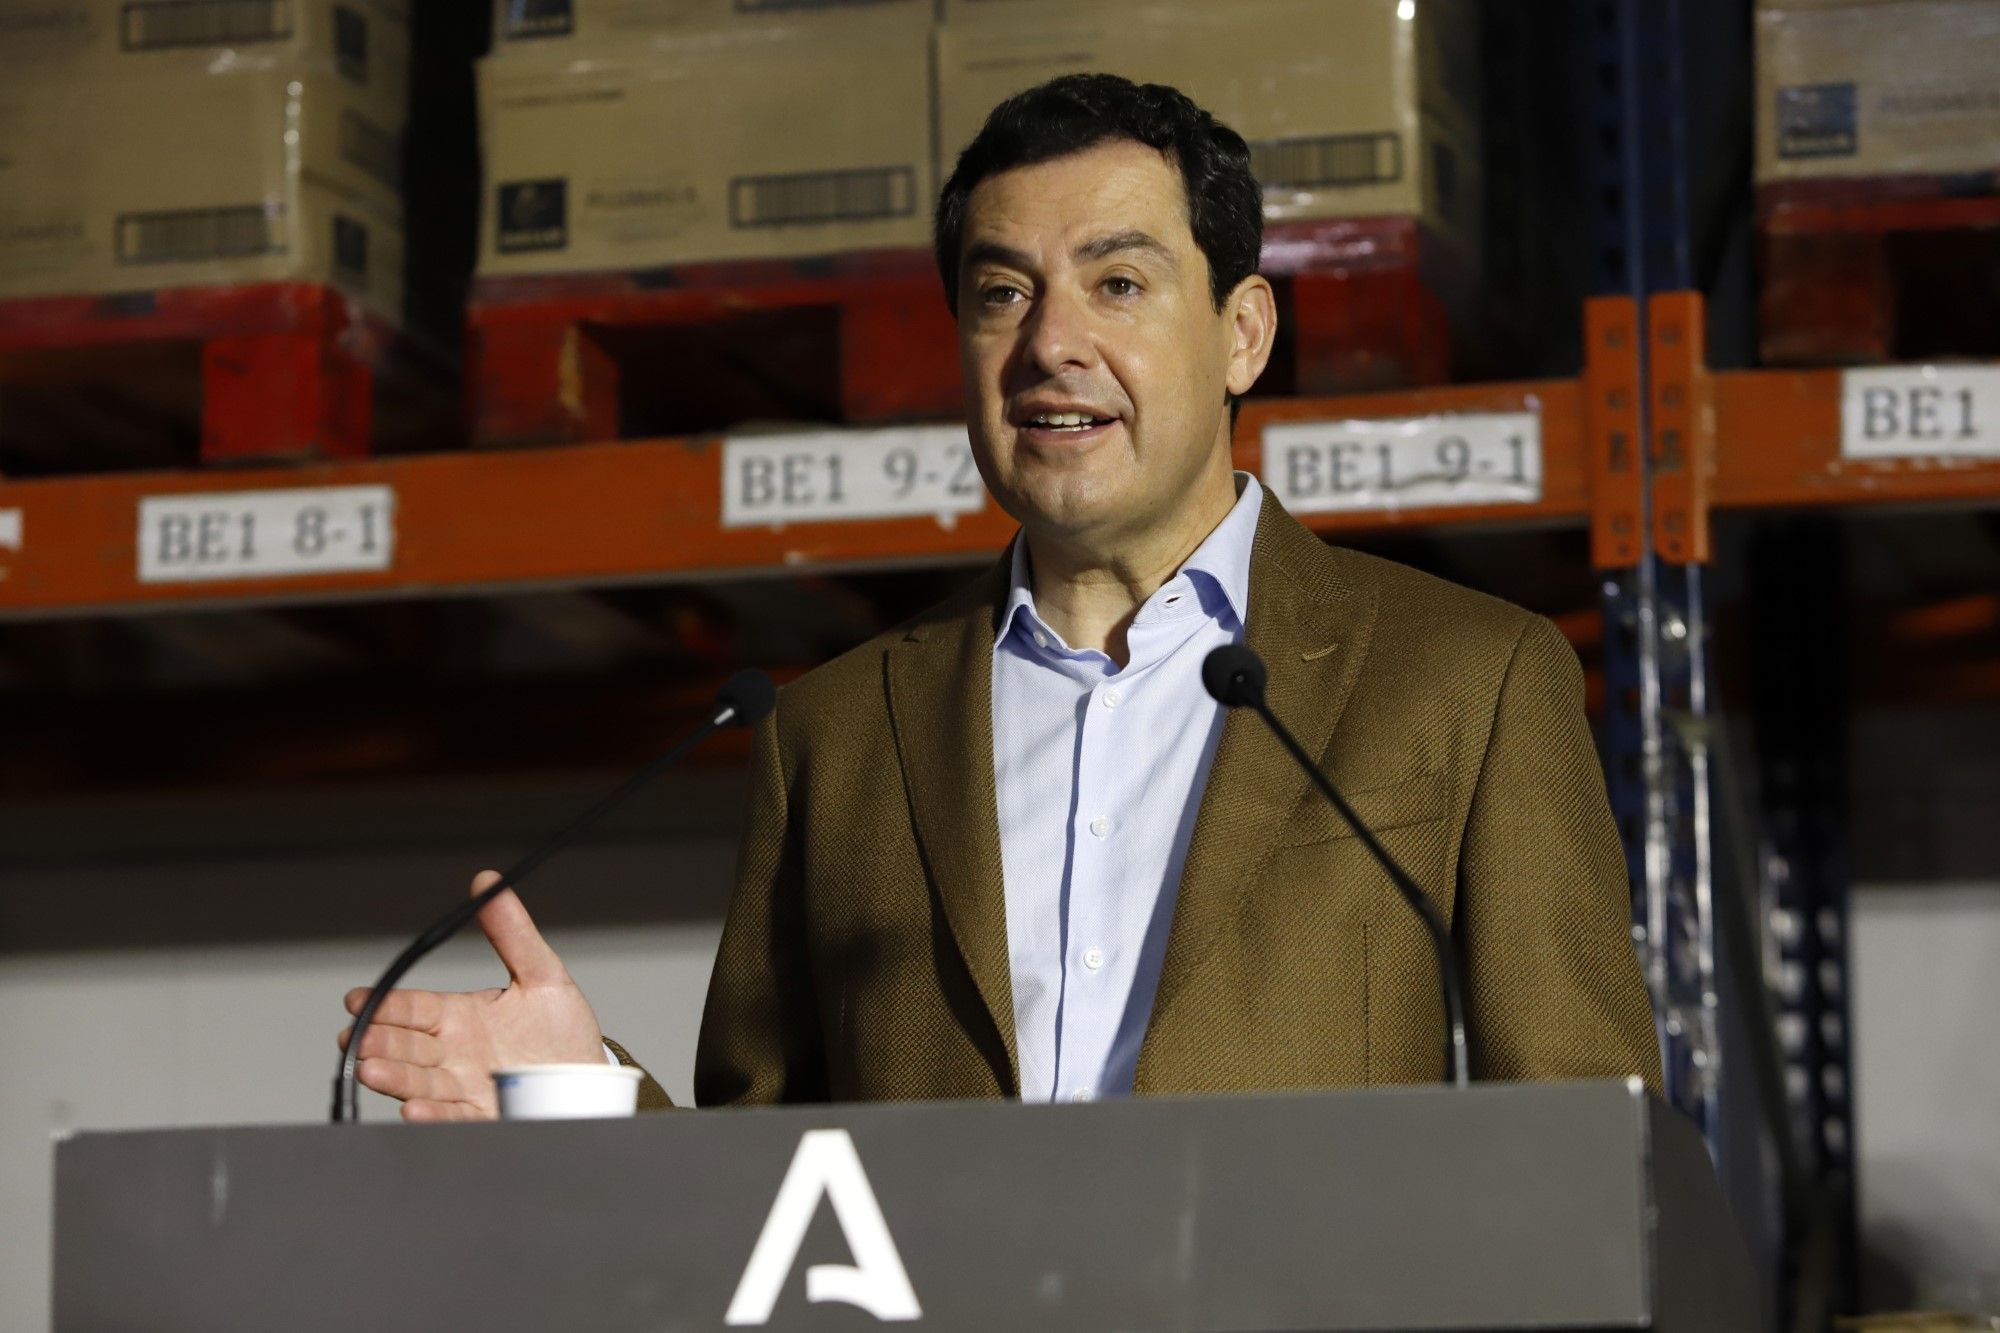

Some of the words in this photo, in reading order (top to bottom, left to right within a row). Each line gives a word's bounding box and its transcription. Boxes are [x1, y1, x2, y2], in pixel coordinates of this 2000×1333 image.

[1863, 385, 1978, 440] BE1
[741, 452, 846, 505] BE1
[882, 444, 976, 498] 9-2
[1286, 442, 1394, 496] BE1
[1435, 433, 1527, 483] 9-1
[158, 511, 256, 564] BE1
[294, 504, 376, 556] 8-1
